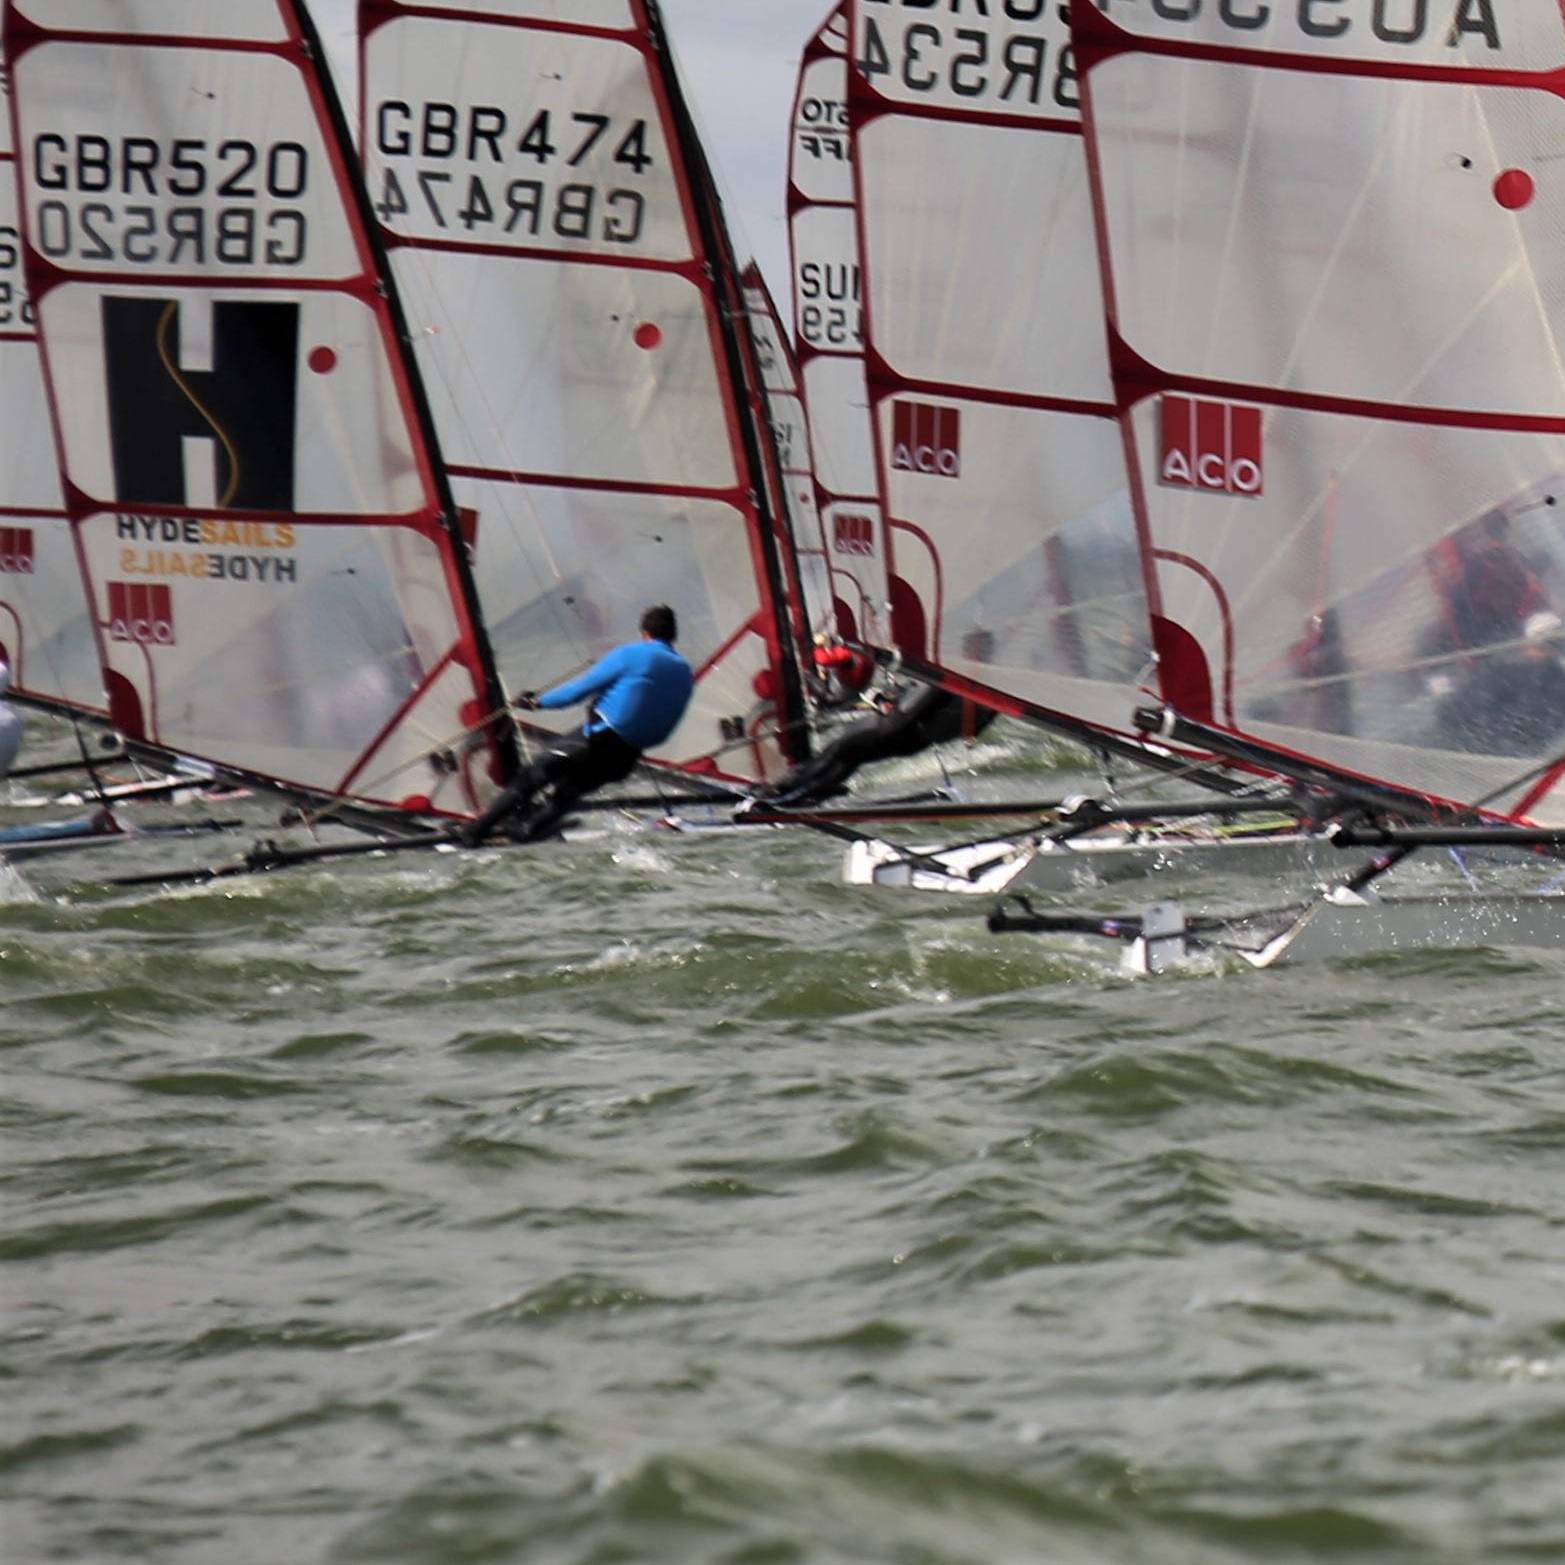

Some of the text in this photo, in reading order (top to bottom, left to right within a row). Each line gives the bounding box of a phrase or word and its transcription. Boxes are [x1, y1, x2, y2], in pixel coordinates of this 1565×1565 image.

[377, 100, 653, 174] GBR474
[33, 132, 308, 198] GBR520
[894, 442, 958, 476] ACO
[1162, 448, 1262, 491] ACO
